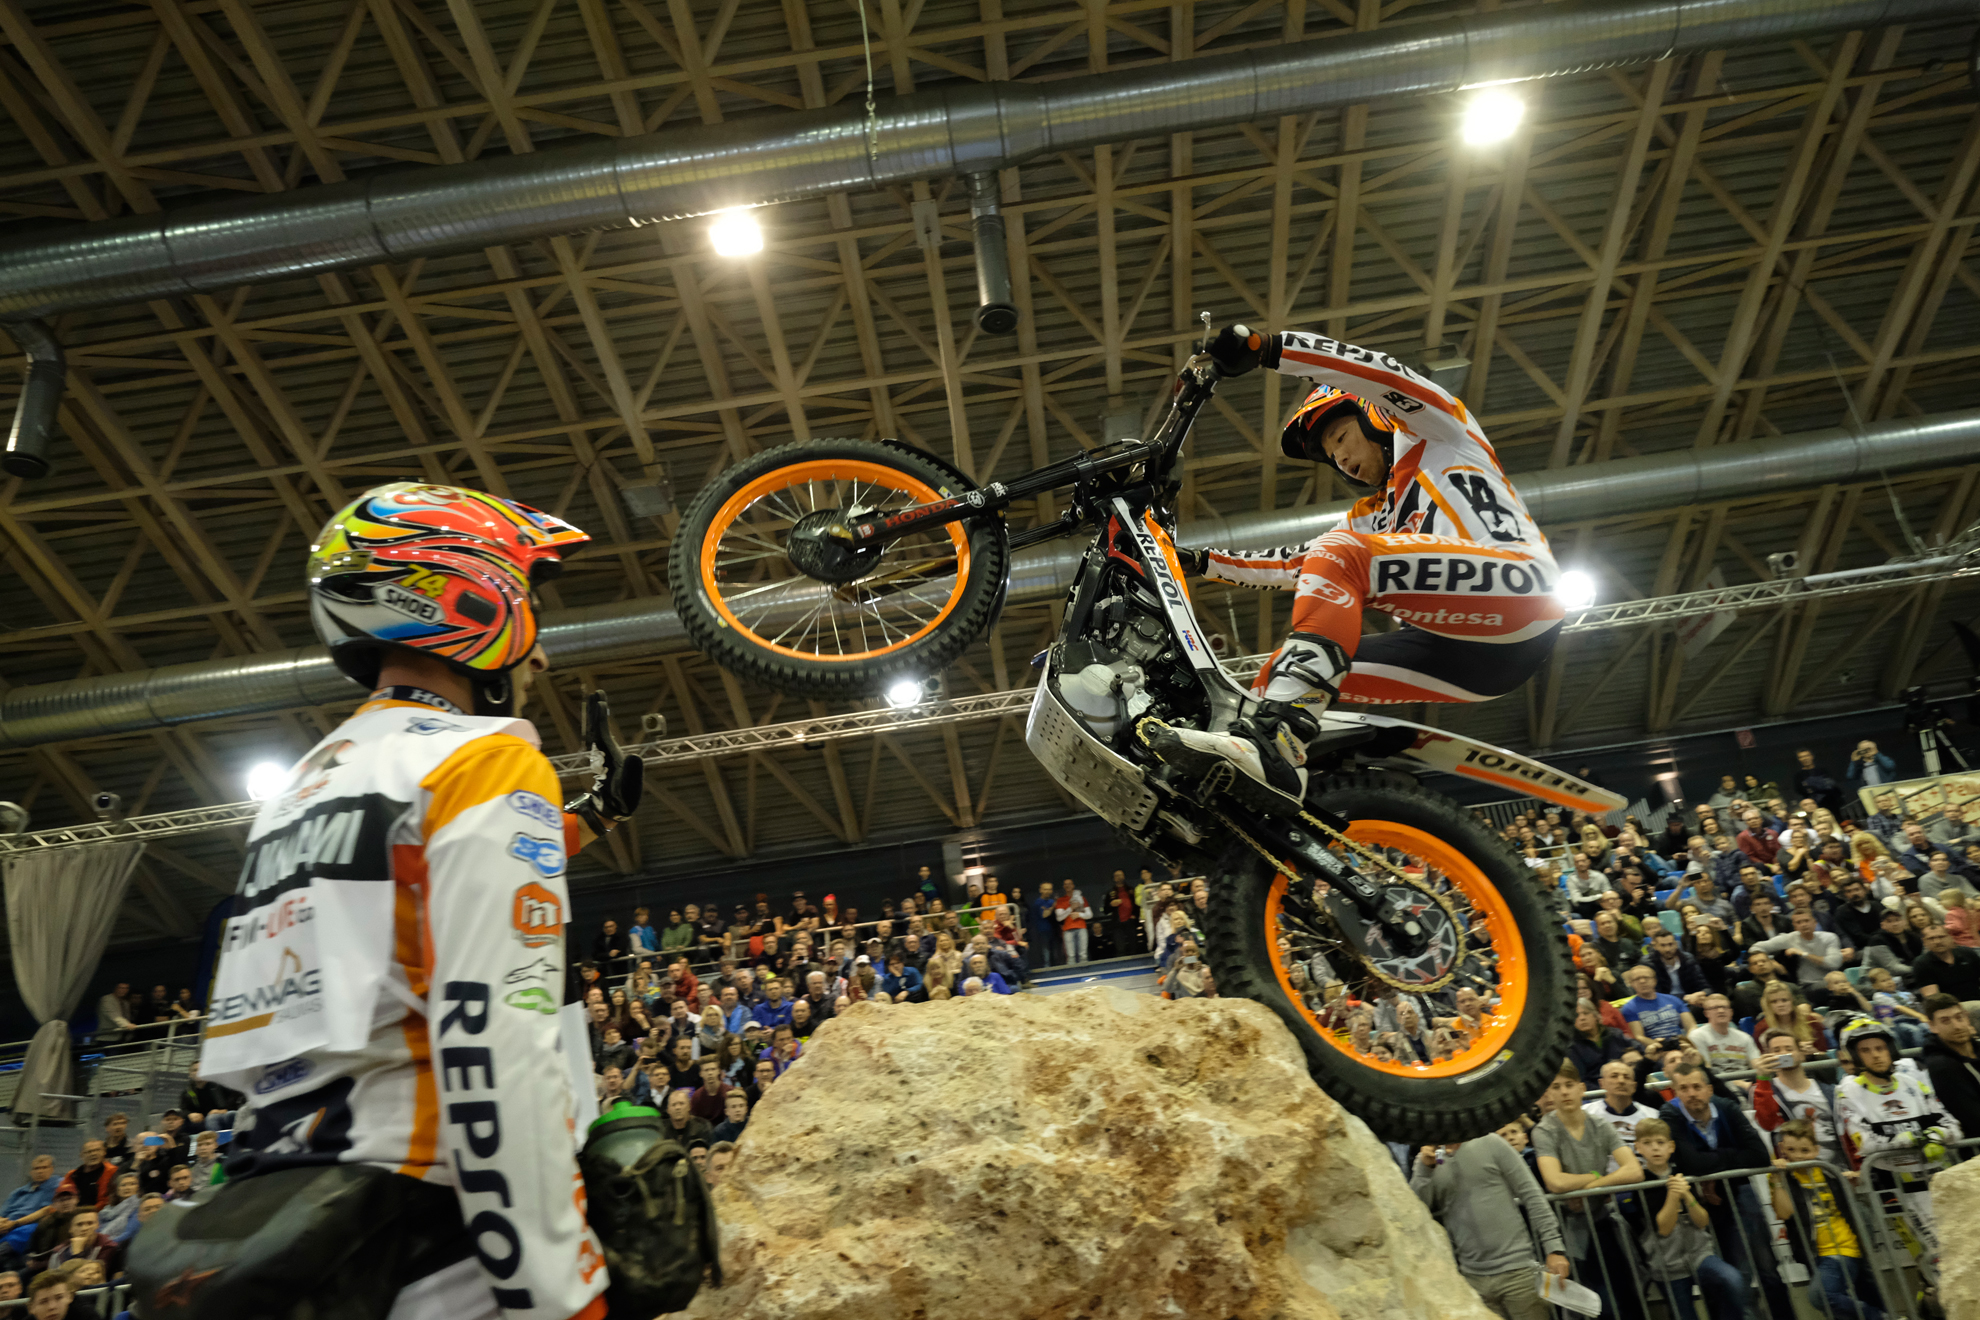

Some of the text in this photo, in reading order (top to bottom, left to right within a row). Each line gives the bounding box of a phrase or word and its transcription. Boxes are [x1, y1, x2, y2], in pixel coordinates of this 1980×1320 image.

[884, 499, 960, 528] HONDA
[400, 563, 449, 599] 74
[1137, 532, 1184, 610] REPSOL
[1377, 557, 1556, 595] REPSOL
[384, 588, 438, 620] SHOEI
[438, 981, 535, 1311] REPSOL
